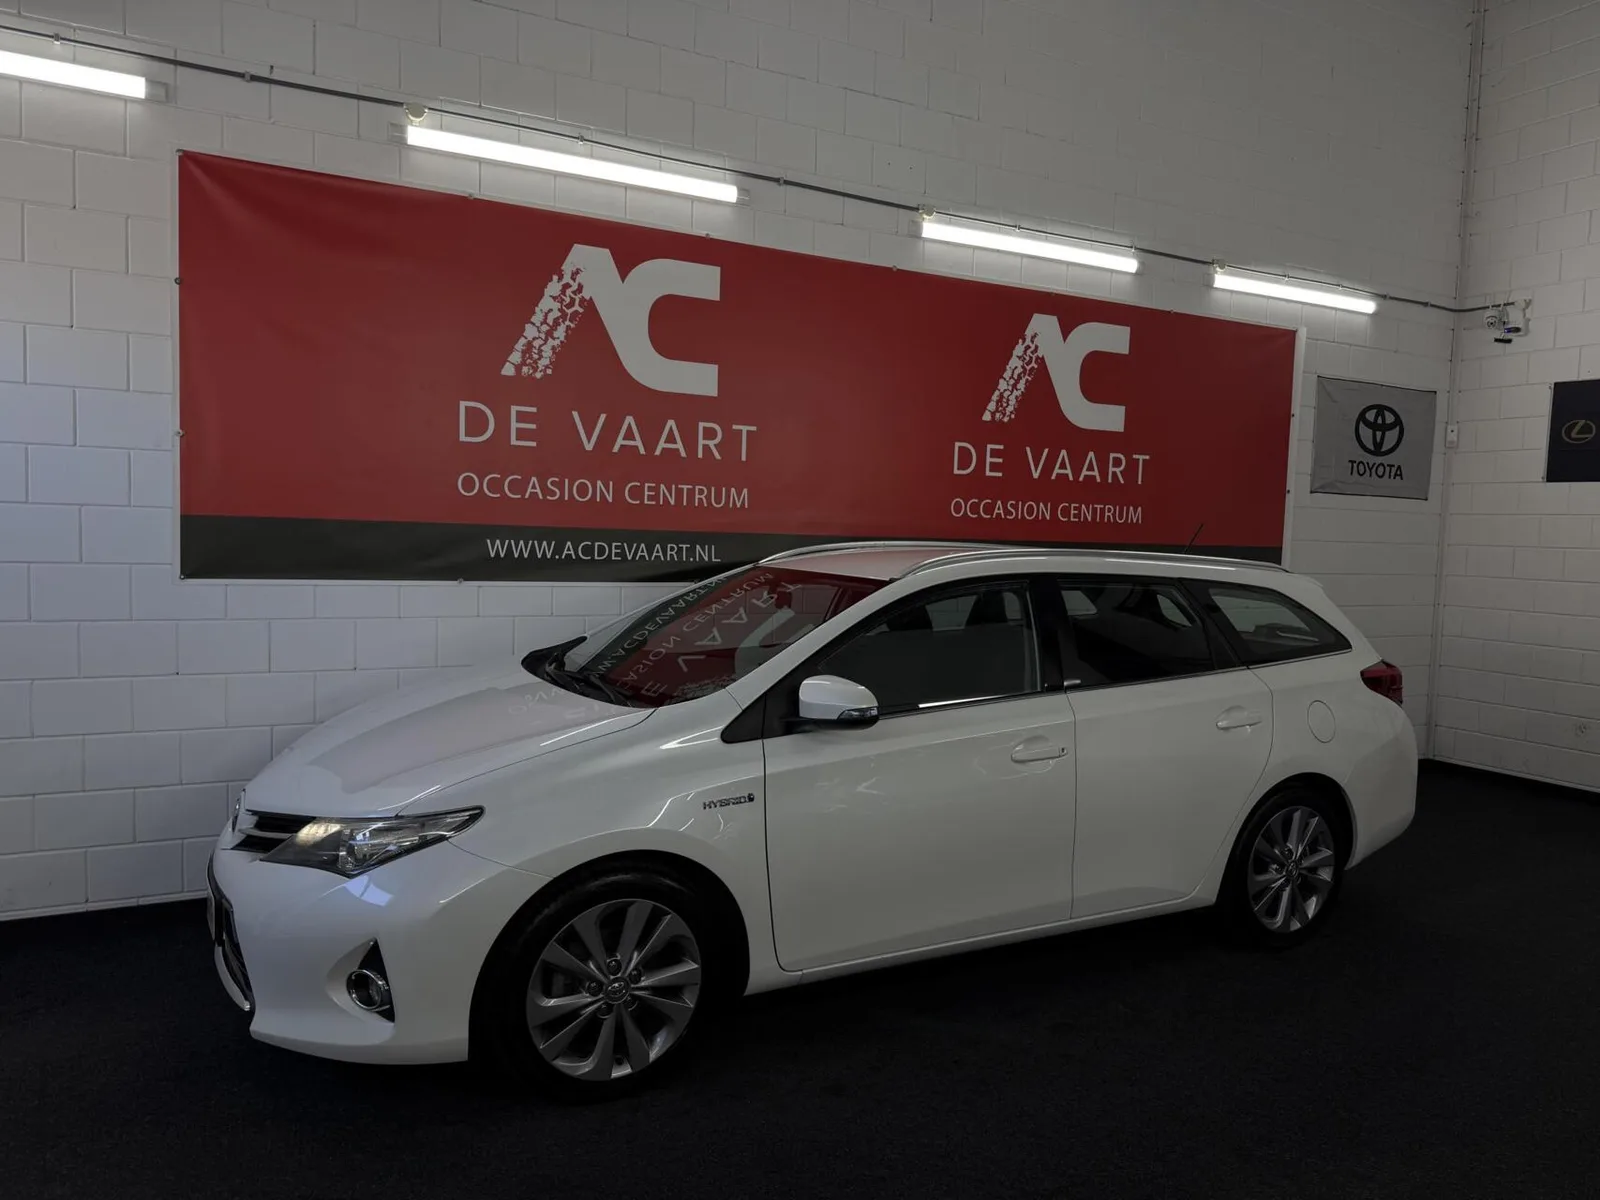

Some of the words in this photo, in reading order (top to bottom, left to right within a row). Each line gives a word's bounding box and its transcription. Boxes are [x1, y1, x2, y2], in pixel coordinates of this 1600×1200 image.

[458, 400, 538, 447] DE
[572, 410, 757, 462] VAART
[953, 441, 1005, 477] DE
[1025, 446, 1150, 484] VAART
[1348, 459, 1404, 480] TOYOTA
[457, 472, 613, 503] OCCASION
[624, 481, 749, 509] CENTRUM
[950, 498, 1051, 520] OCCASION
[1057, 502, 1142, 524] CENTRUM
[486, 539, 722, 562] WWW.ACDEVAART.NL
